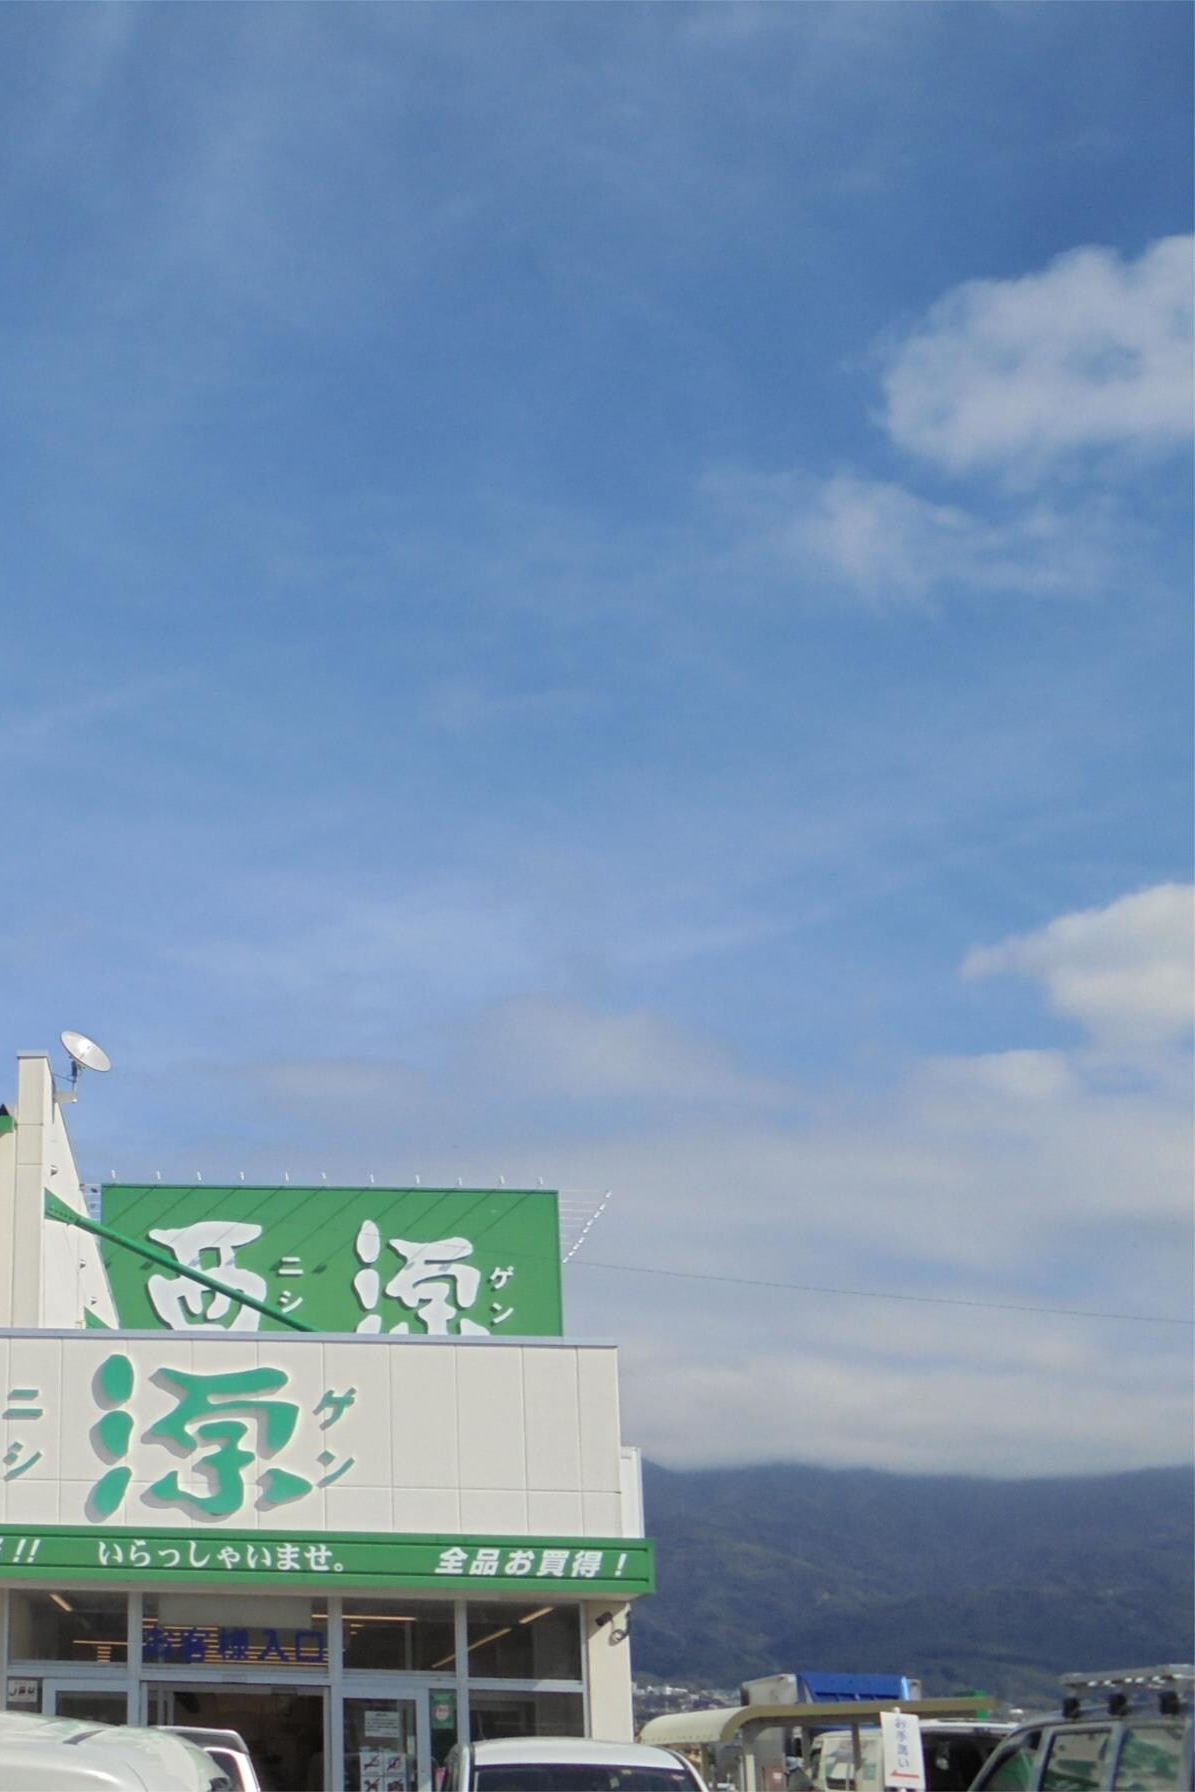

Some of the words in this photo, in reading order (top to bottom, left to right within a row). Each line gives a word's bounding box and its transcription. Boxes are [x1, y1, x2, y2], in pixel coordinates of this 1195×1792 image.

[277, 1256, 304, 1314] ニシ
[489, 1265, 515, 1325] ゲン
[4, 1388, 44, 1481] ニシ
[103, 1353, 313, 1516] 源
[314, 1387, 357, 1487] ゲン
[97, 1541, 346, 1572] いらっしゃいませ。
[434, 1547, 628, 1578] 全品お買得!
